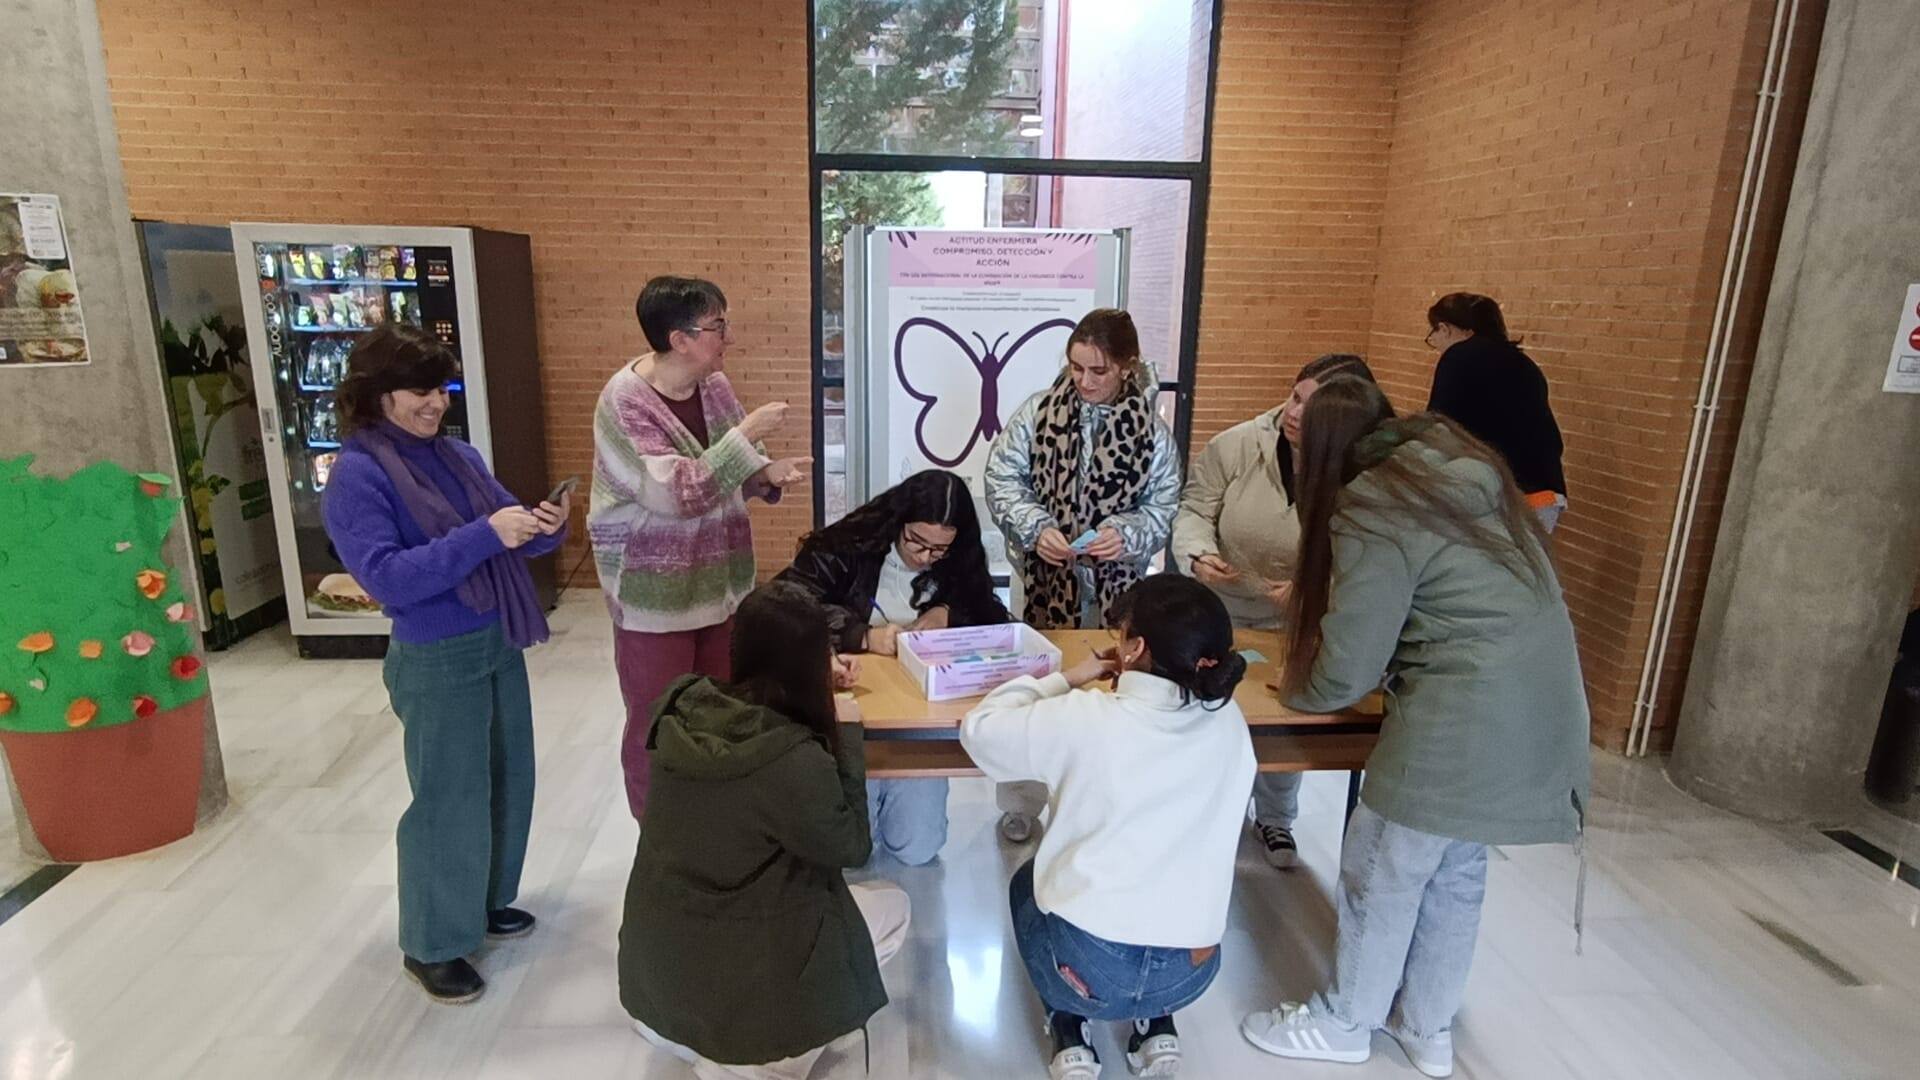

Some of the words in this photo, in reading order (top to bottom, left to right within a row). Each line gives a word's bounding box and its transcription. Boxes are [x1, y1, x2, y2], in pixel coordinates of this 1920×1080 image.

[949, 236, 985, 245] ACTITUD
[987, 236, 1037, 245] ENFERMERA
[976, 257, 1010, 267] ACCIÓN
